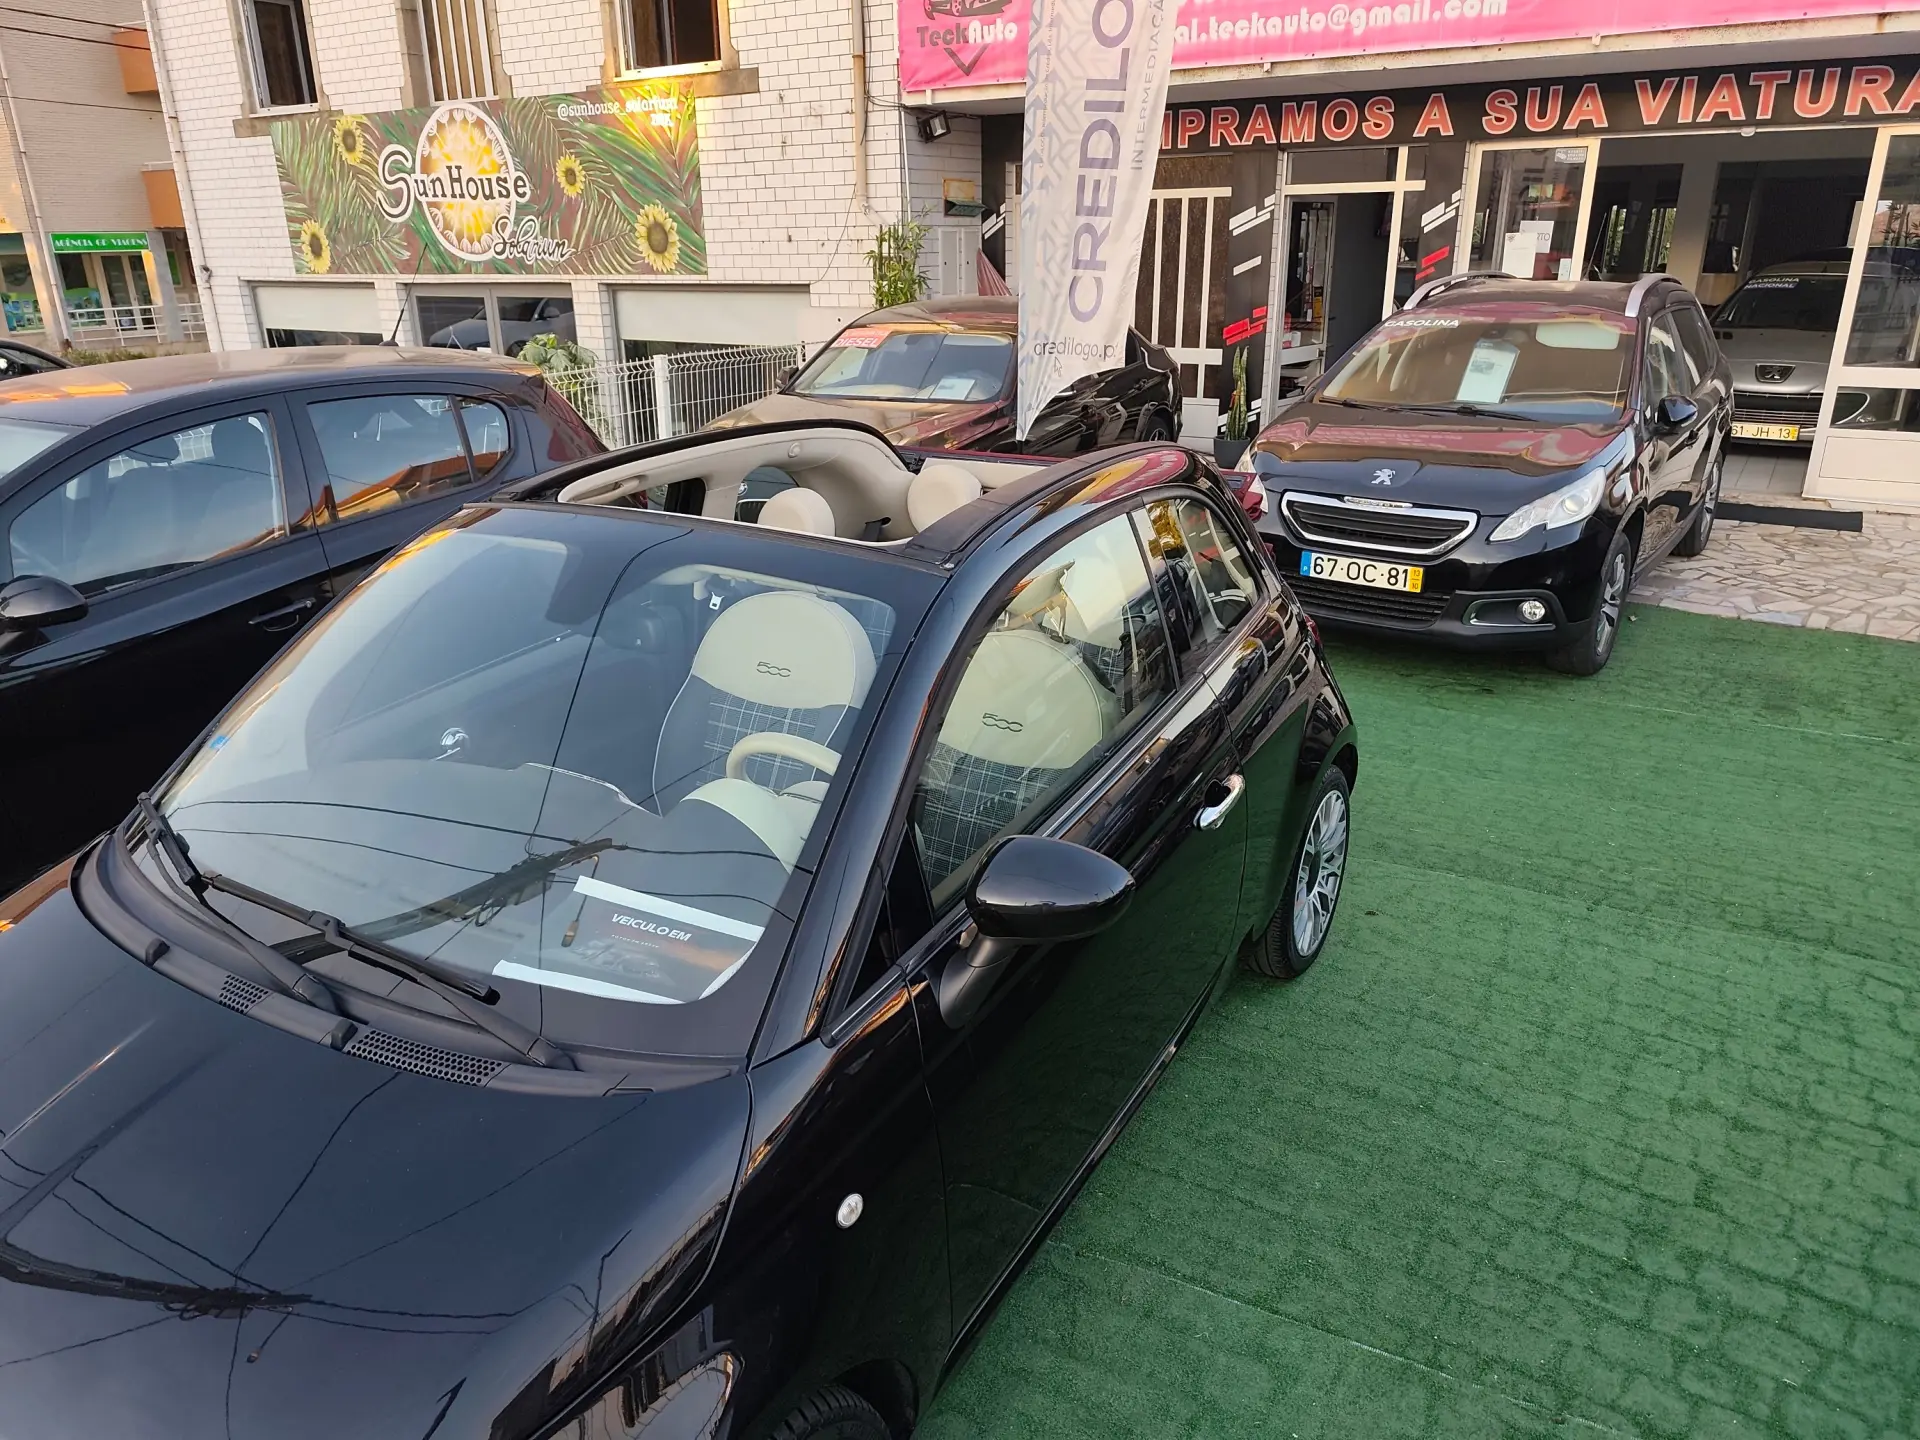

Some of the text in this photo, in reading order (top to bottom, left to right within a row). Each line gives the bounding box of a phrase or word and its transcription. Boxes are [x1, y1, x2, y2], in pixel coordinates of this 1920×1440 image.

[916, 18, 1018, 47] TeckAuto
[1161, 97, 1395, 149] PRAMOS
[1413, 92, 1454, 137] A
[1482, 83, 1608, 134] SUA
[493, 214, 573, 262] Solarium
[1385, 319, 1459, 328] GASOLINA
[756, 660, 791, 678] 500
[982, 712, 1023, 733] 500
[611, 913, 670, 935] VEICULO
[668, 929, 692, 942] EM
